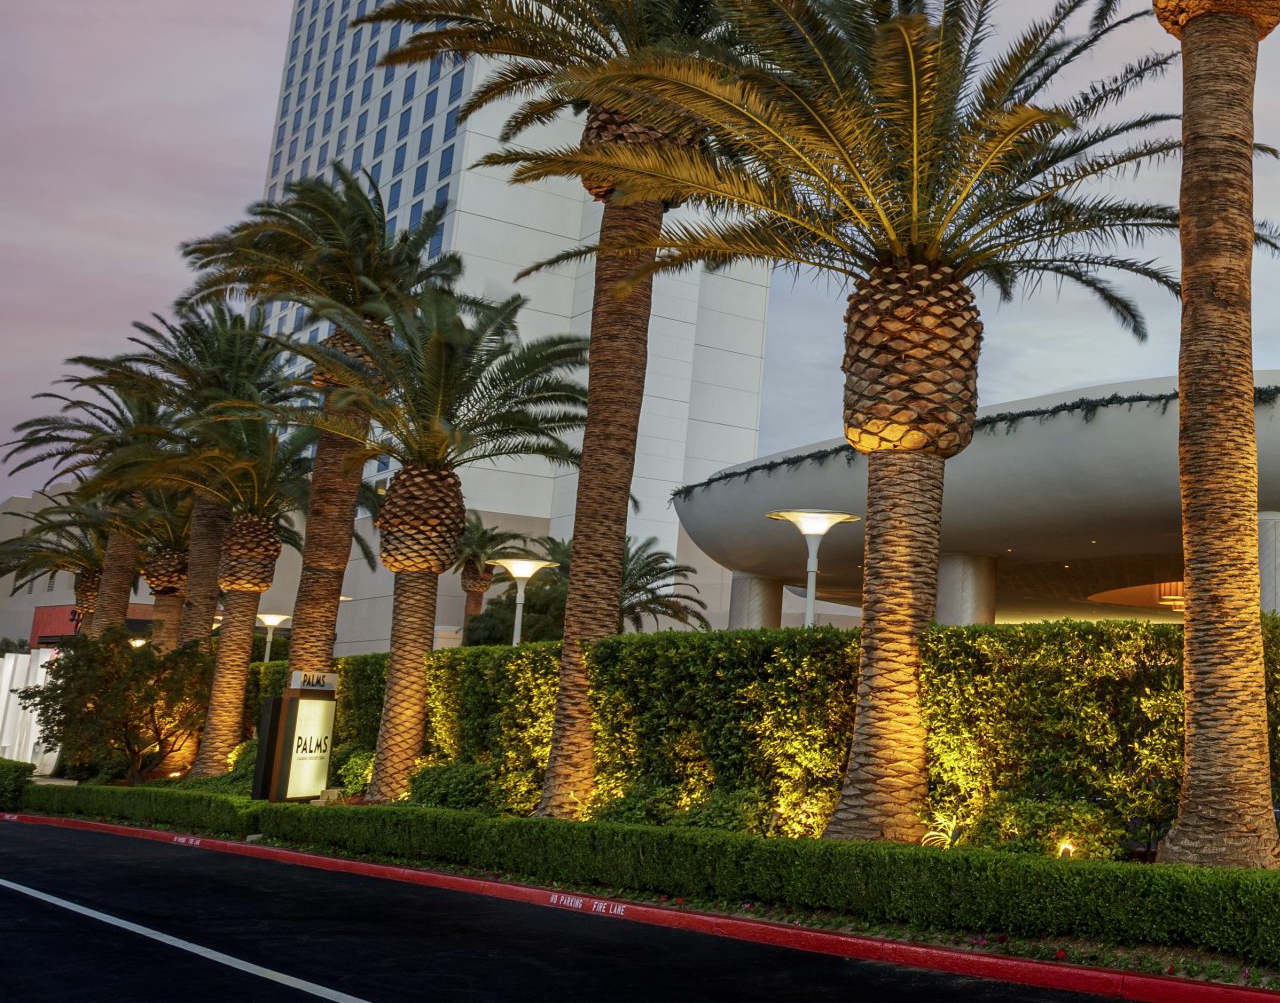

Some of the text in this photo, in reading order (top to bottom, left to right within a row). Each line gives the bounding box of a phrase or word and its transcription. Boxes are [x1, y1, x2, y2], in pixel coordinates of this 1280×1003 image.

[303, 674, 325, 687] PALMS
[296, 736, 328, 753] PALMS
[550, 893, 625, 915] NO PARKING FIRE LANE
